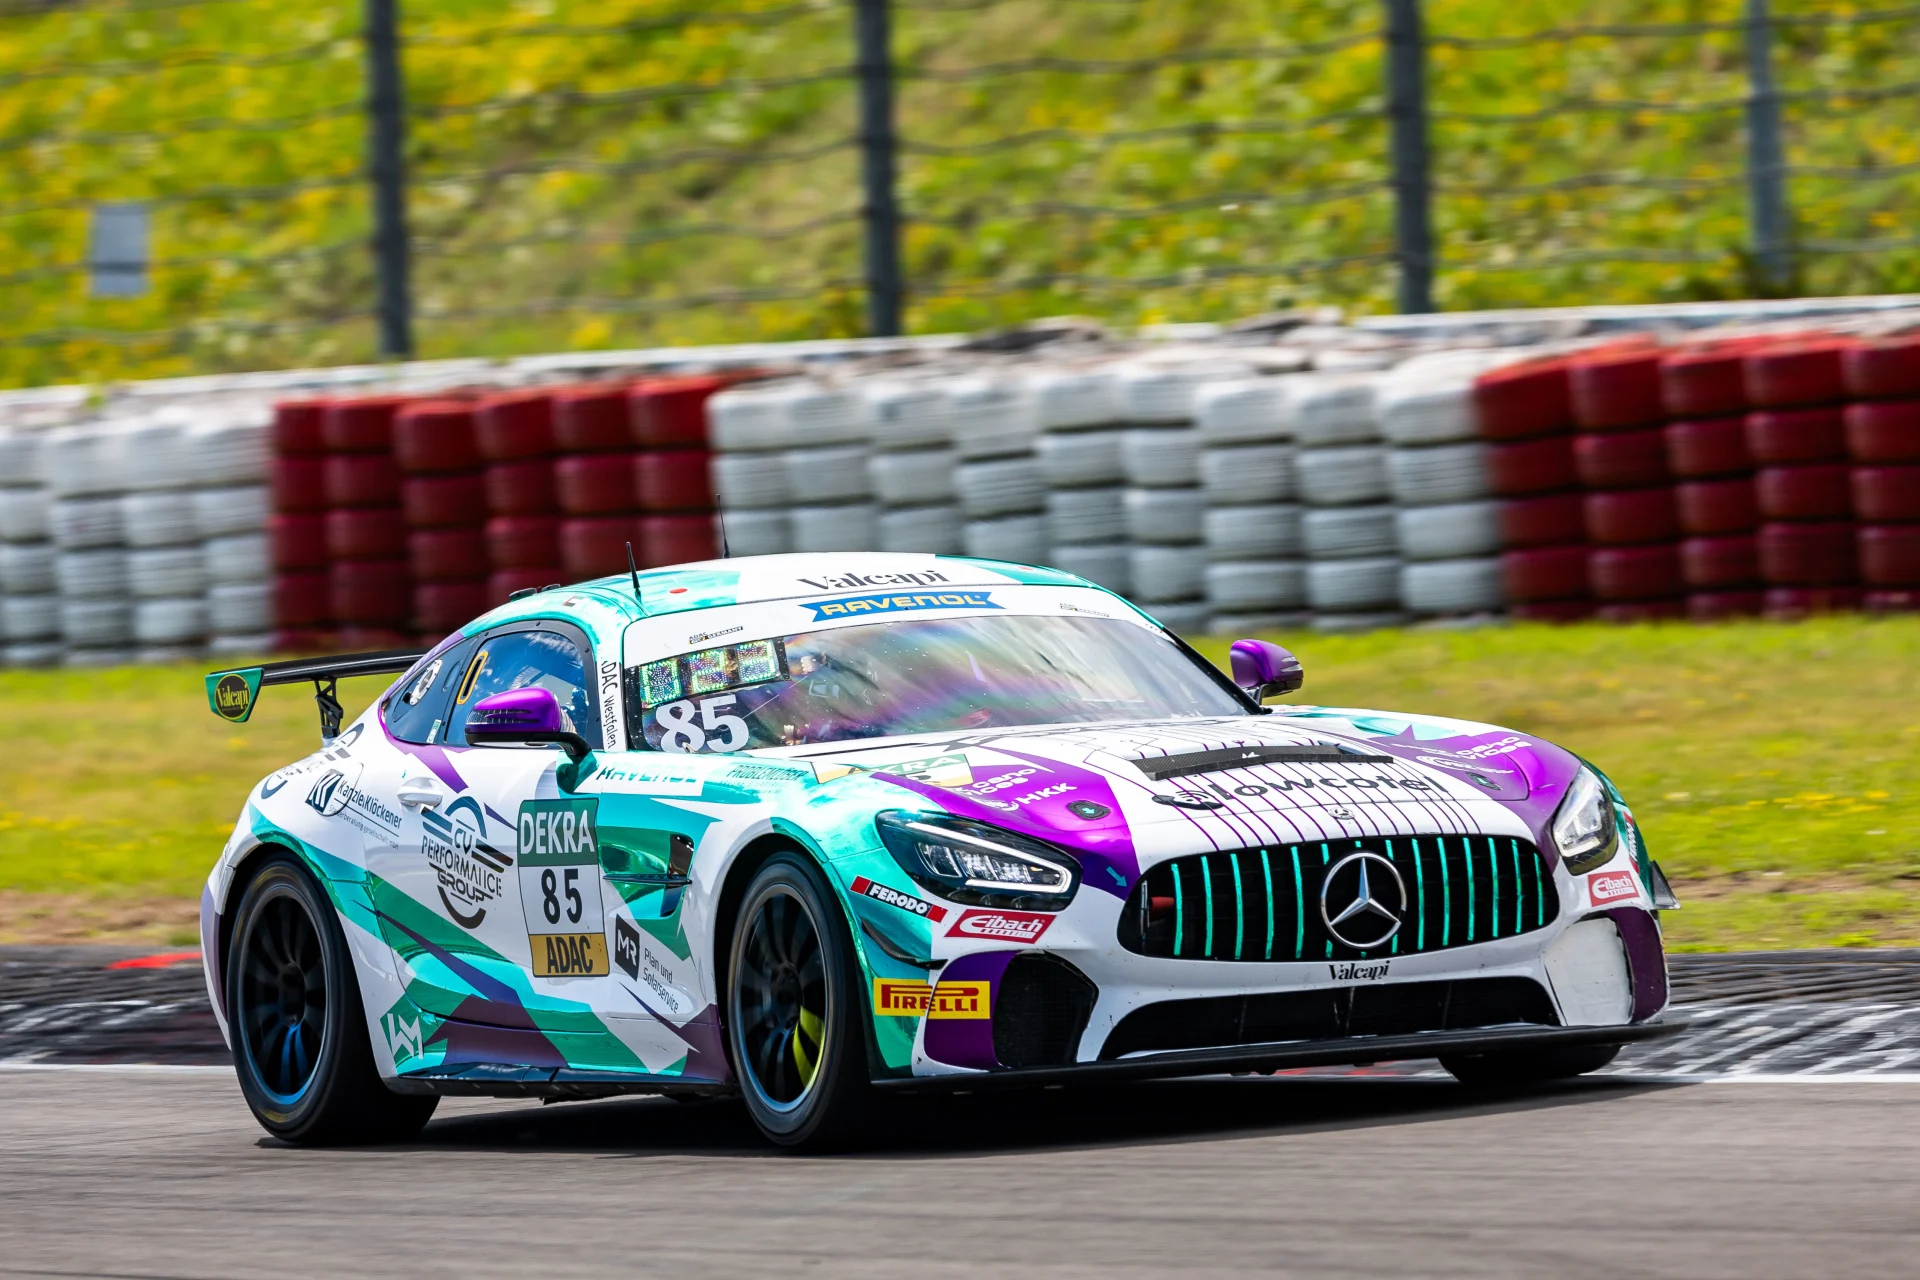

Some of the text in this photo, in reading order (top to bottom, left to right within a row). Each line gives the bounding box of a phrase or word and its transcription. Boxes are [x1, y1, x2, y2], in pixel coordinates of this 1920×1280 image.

[796, 570, 950, 590] Valcapi
[820, 594, 987, 615] RAVENOL
[217, 684, 249, 710] Valcapi
[603, 695, 618, 749] Westfalen
[656, 694, 749, 752] 85
[1016, 783, 1077, 804] HKK
[520, 809, 595, 855] DEKRA
[421, 835, 502, 898] PERFORMANCE
[434, 866, 489, 903] GROUP
[541, 868, 583, 925] 85
[868, 885, 926, 915] FERODO
[1592, 876, 1633, 898] Eibach
[960, 915, 1043, 934] Eibach
[546, 935, 593, 974] ADAC
[644, 947, 673, 984] Plan und
[1328, 960, 1391, 980] Valcapi
[643, 967, 679, 1014] Solarservice
[881, 984, 979, 1012] PIRELLI
